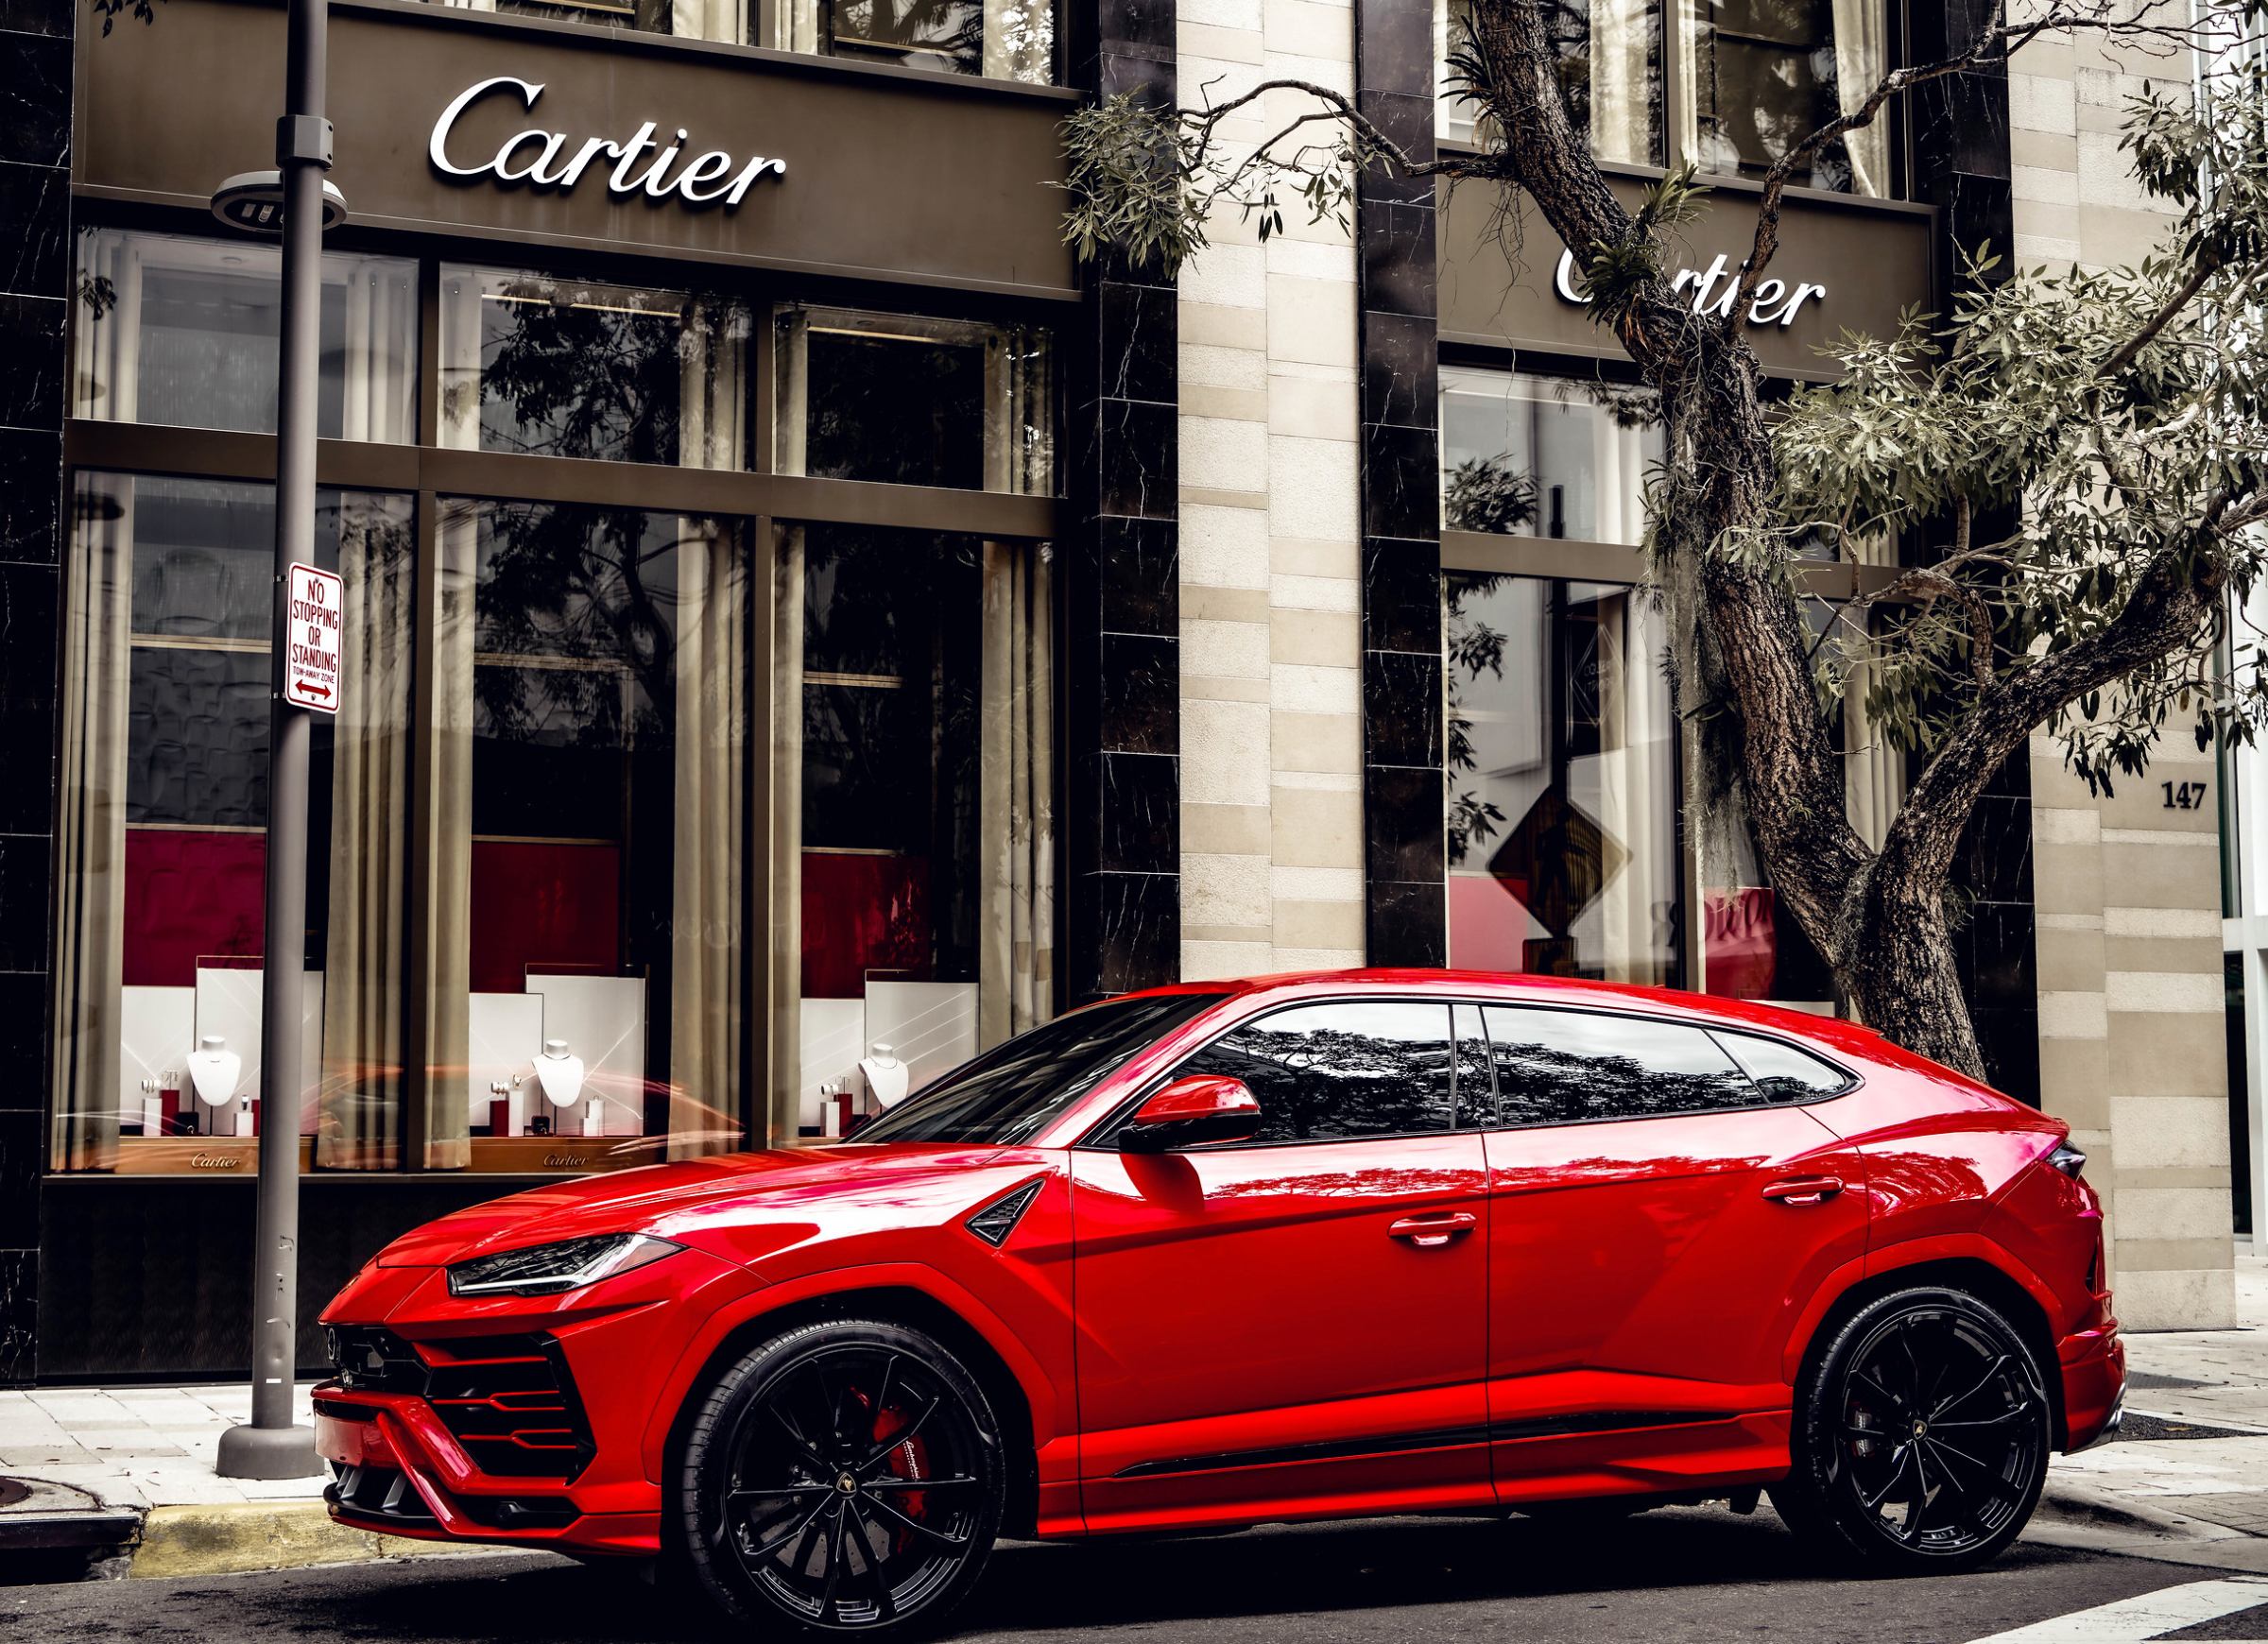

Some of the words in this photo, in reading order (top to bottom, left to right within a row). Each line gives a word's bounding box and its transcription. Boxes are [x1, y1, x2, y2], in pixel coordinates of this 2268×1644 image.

[430, 77, 787, 205] Cartier
[1555, 247, 1827, 326] Crtier
[307, 579, 325, 605] NO
[293, 599, 338, 630] STOPPING
[308, 625, 321, 647] OR
[292, 643, 336, 673] STANDING
[293, 665, 320, 680] TOW-AWAY
[320, 673, 335, 684] ZONE
[2161, 780, 2208, 810] 147
[191, 1152, 241, 1169] Cartier
[542, 1153, 590, 1168] Cartier
